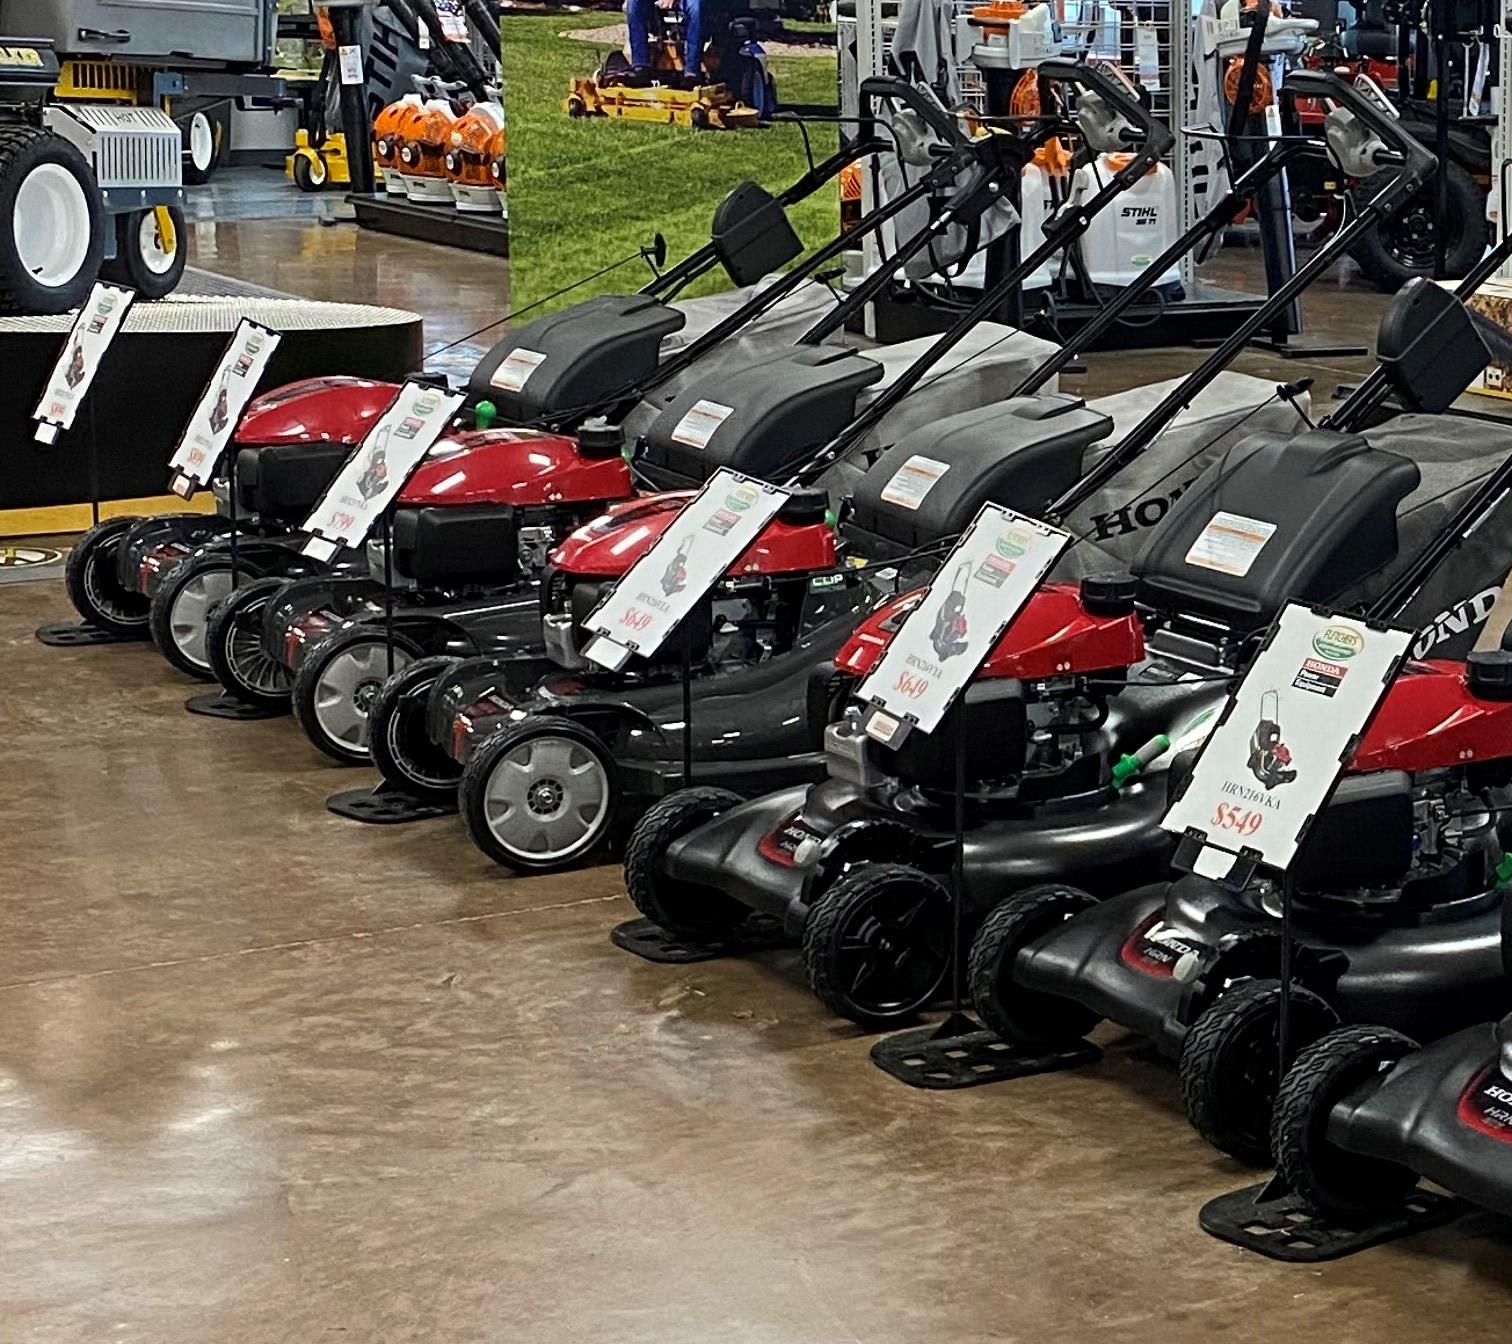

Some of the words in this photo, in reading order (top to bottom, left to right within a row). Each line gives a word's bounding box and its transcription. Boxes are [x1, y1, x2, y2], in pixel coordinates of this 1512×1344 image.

[1121, 207, 1158, 218] STIHL
[1305, 659, 1341, 675] HONDA
[893, 671, 929, 700] $649
[1221, 780, 1281, 810] HRN216VKA
[1210, 802, 1264, 836] $549
